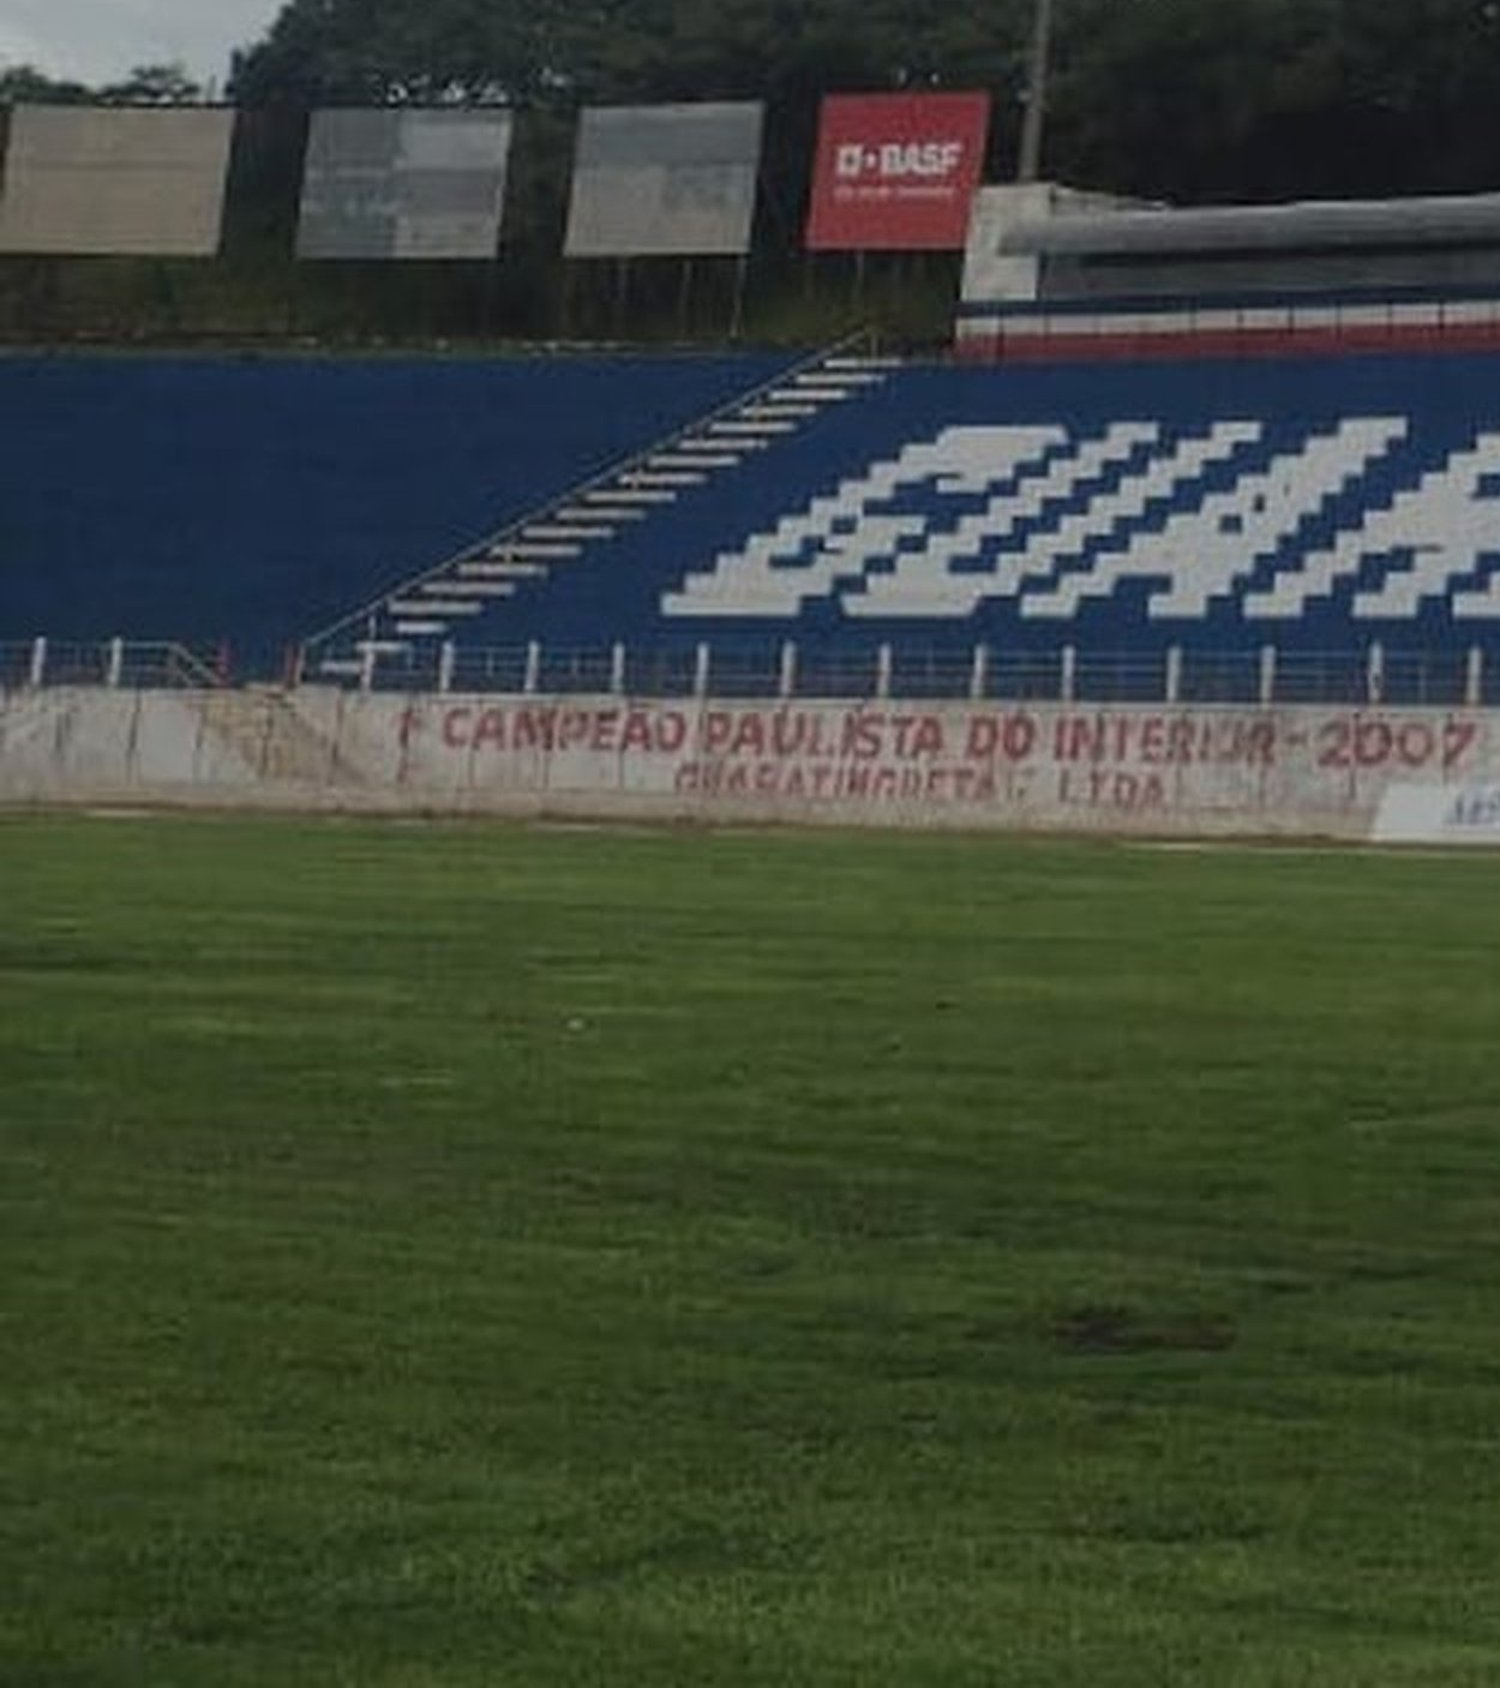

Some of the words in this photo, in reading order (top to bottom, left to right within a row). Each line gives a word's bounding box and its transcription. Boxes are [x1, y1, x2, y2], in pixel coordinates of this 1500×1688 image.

[879, 142, 963, 176] BASF
[704, 708, 944, 759] PAULISTA
[966, 713, 1035, 761] DO
[1317, 718, 1478, 769] 2007
